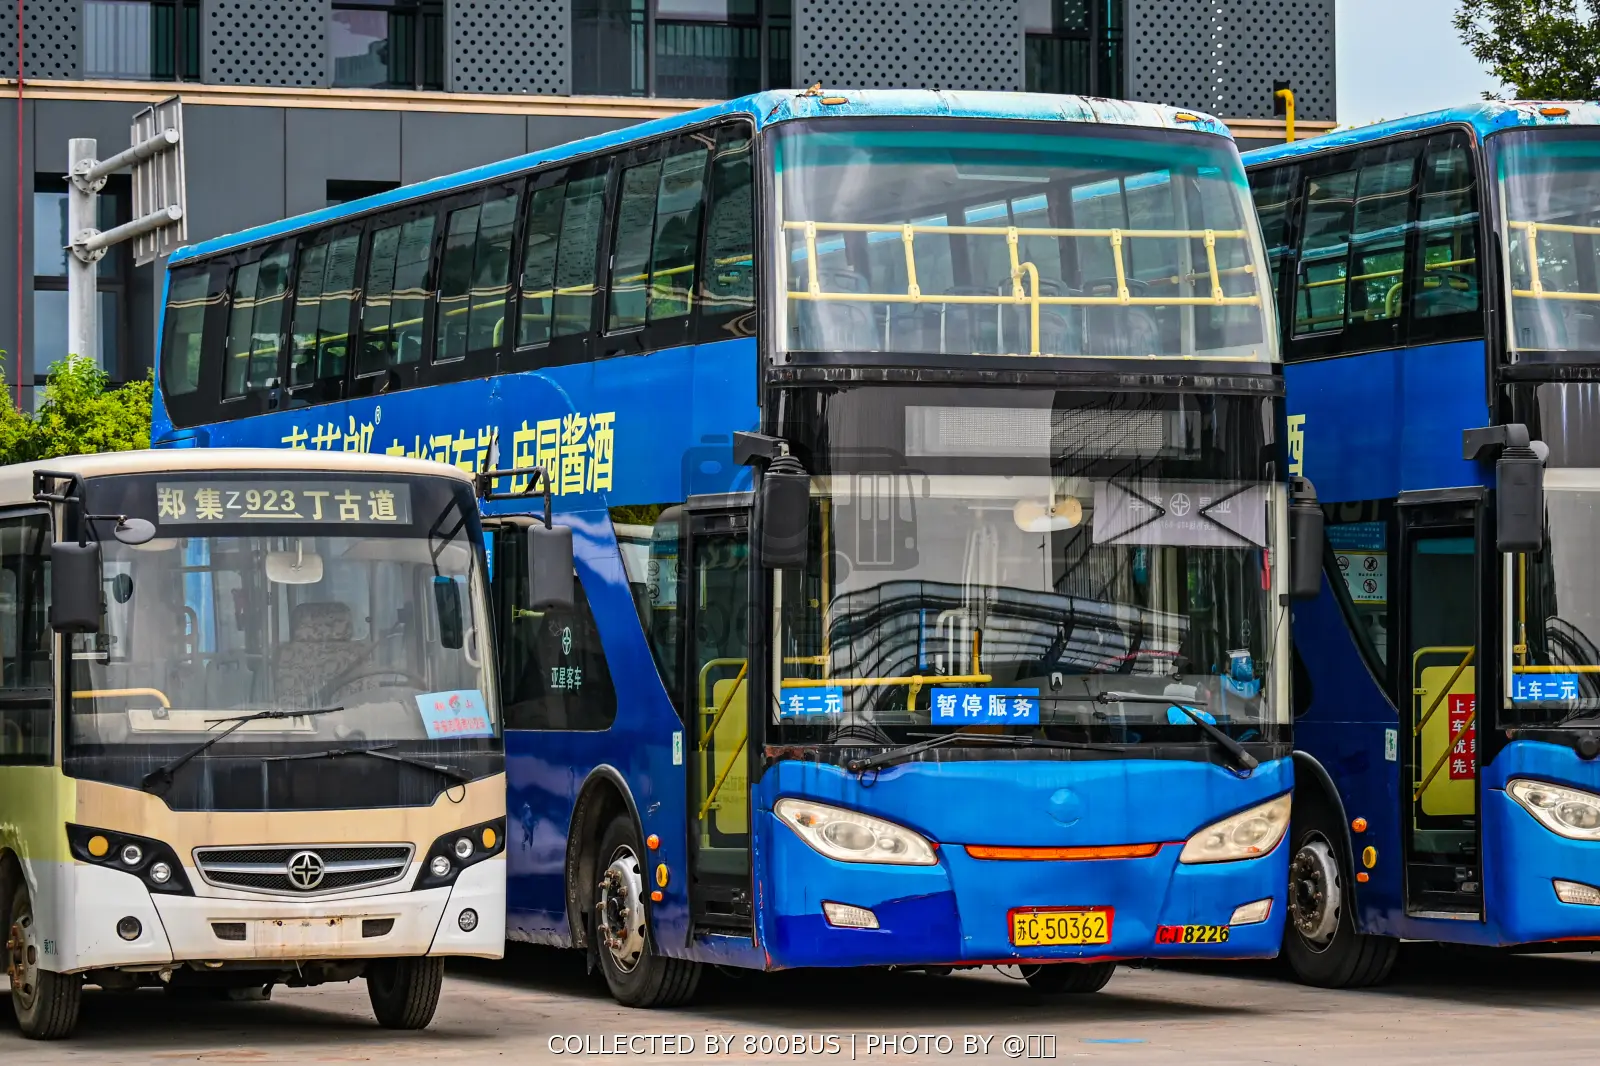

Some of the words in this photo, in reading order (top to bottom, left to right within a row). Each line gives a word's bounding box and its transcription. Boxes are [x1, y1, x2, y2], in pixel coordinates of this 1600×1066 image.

[158, 487, 225, 520] 郑集
[303, 489, 398, 521] 丁古道
[551, 666, 582, 690] 亚星客车
[1513, 681, 1577, 701] 上车二元
[937, 693, 1033, 718] 暂停服务
